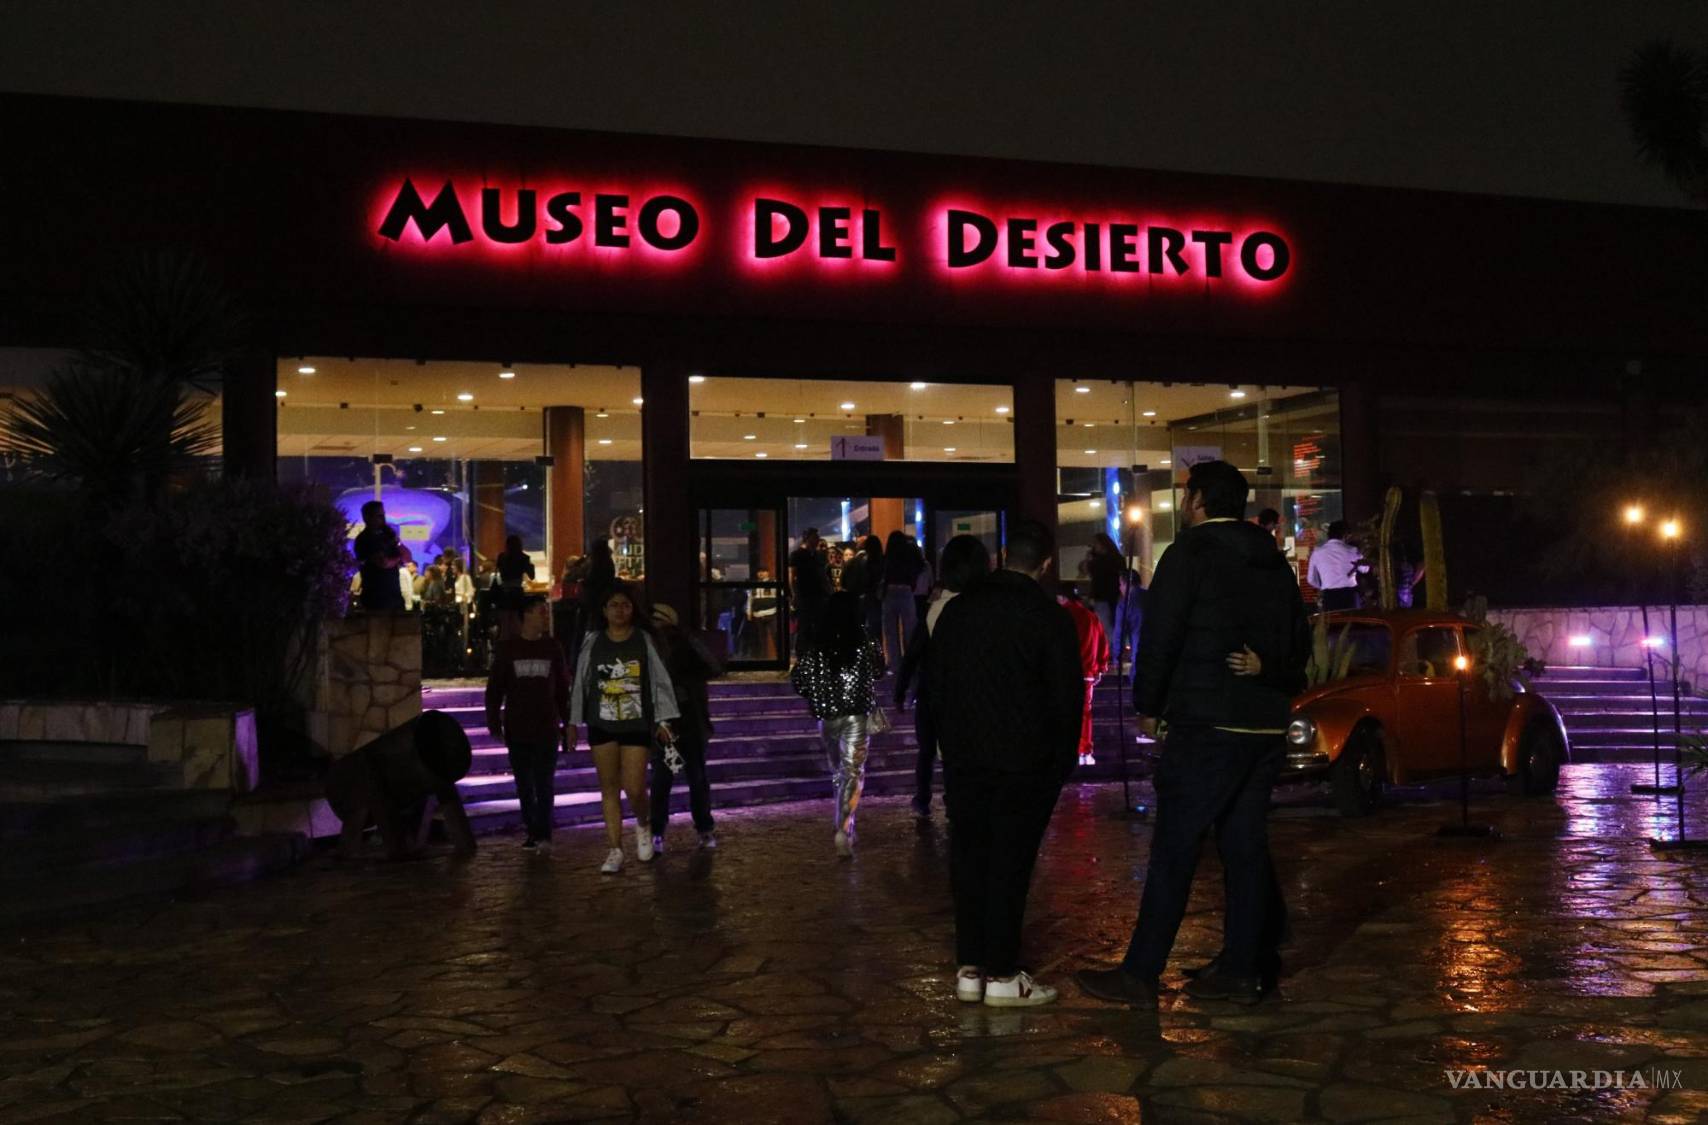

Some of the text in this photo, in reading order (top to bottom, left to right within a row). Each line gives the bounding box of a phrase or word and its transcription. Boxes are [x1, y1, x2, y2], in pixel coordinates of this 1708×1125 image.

[377, 177, 1290, 281] MUSEO DEL DESIERTO
